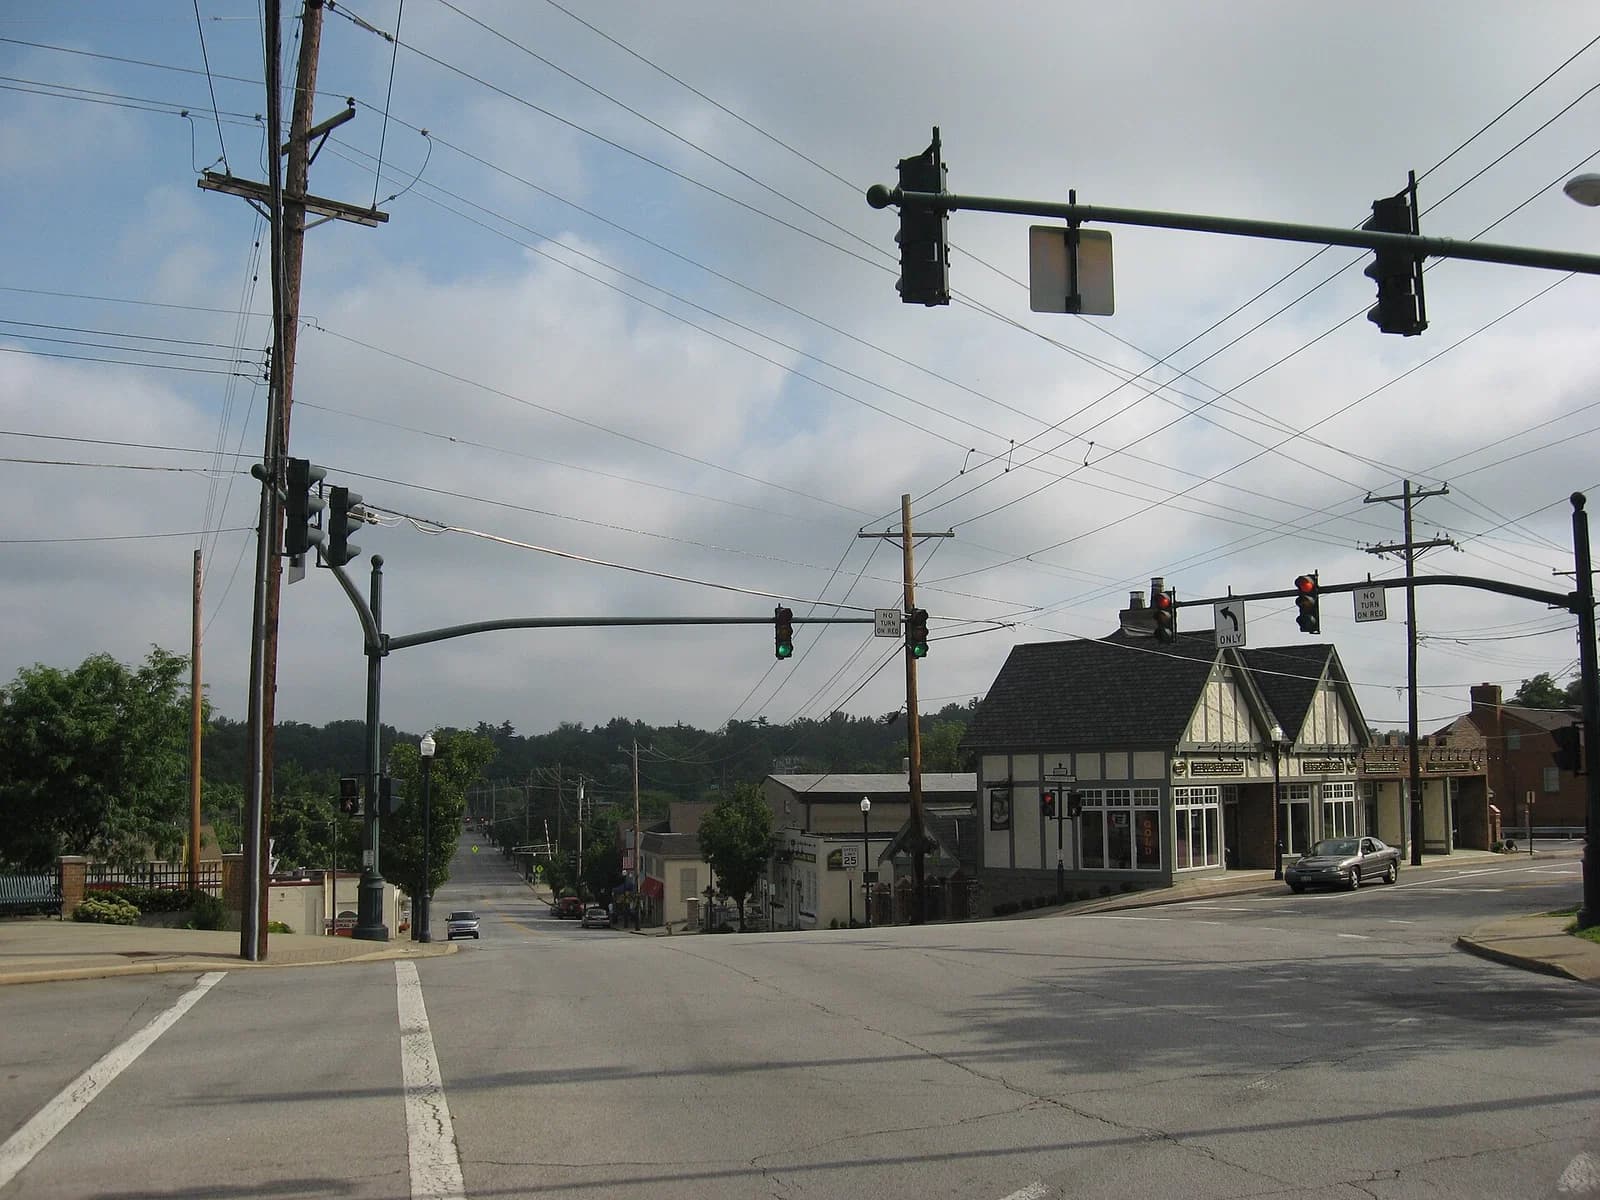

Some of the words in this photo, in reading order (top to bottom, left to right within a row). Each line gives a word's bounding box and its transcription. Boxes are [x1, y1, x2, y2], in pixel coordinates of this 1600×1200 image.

[1363, 591, 1375, 599] NO
[1361, 601, 1380, 609] TURN
[1358, 611, 1368, 619] ON
[1370, 610, 1384, 618] RED
[1220, 633, 1242, 645] ONLY
